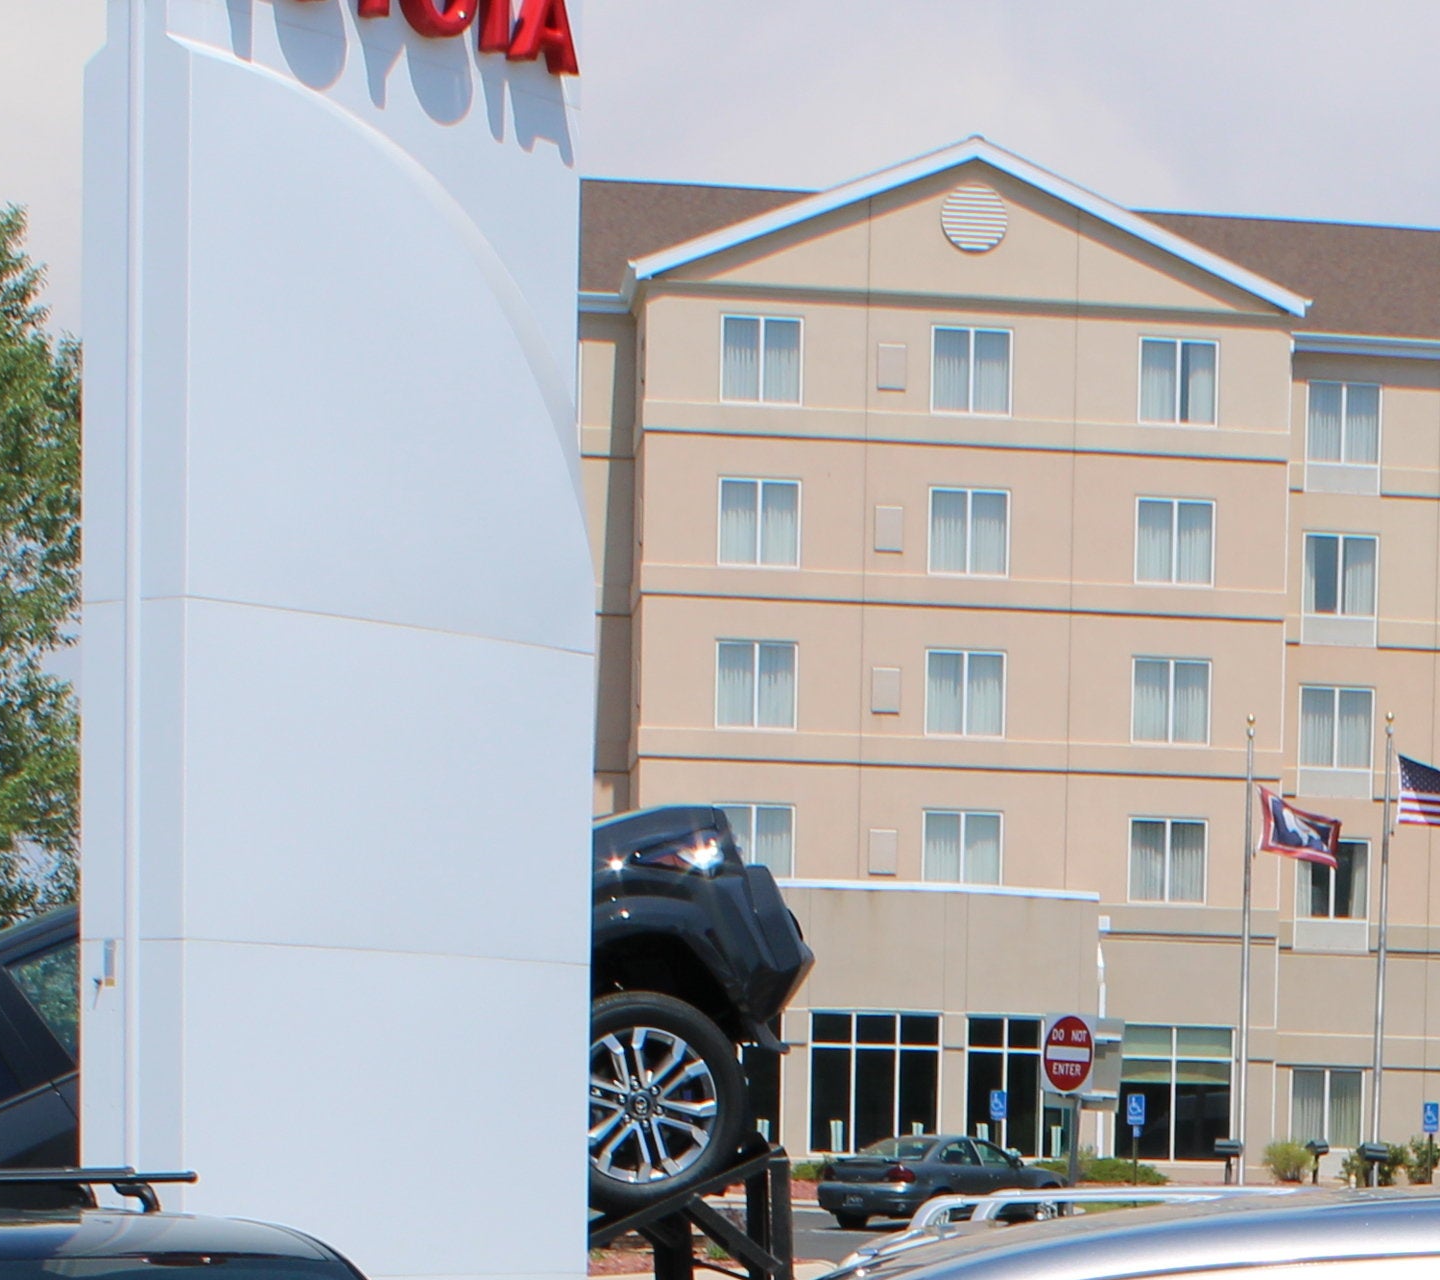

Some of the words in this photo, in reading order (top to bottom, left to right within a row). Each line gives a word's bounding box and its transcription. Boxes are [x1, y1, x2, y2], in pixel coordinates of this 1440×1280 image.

[1051, 1028, 1065, 1041] DO
[1071, 1029, 1088, 1042] NOT
[1052, 1062, 1082, 1076] ENTER
